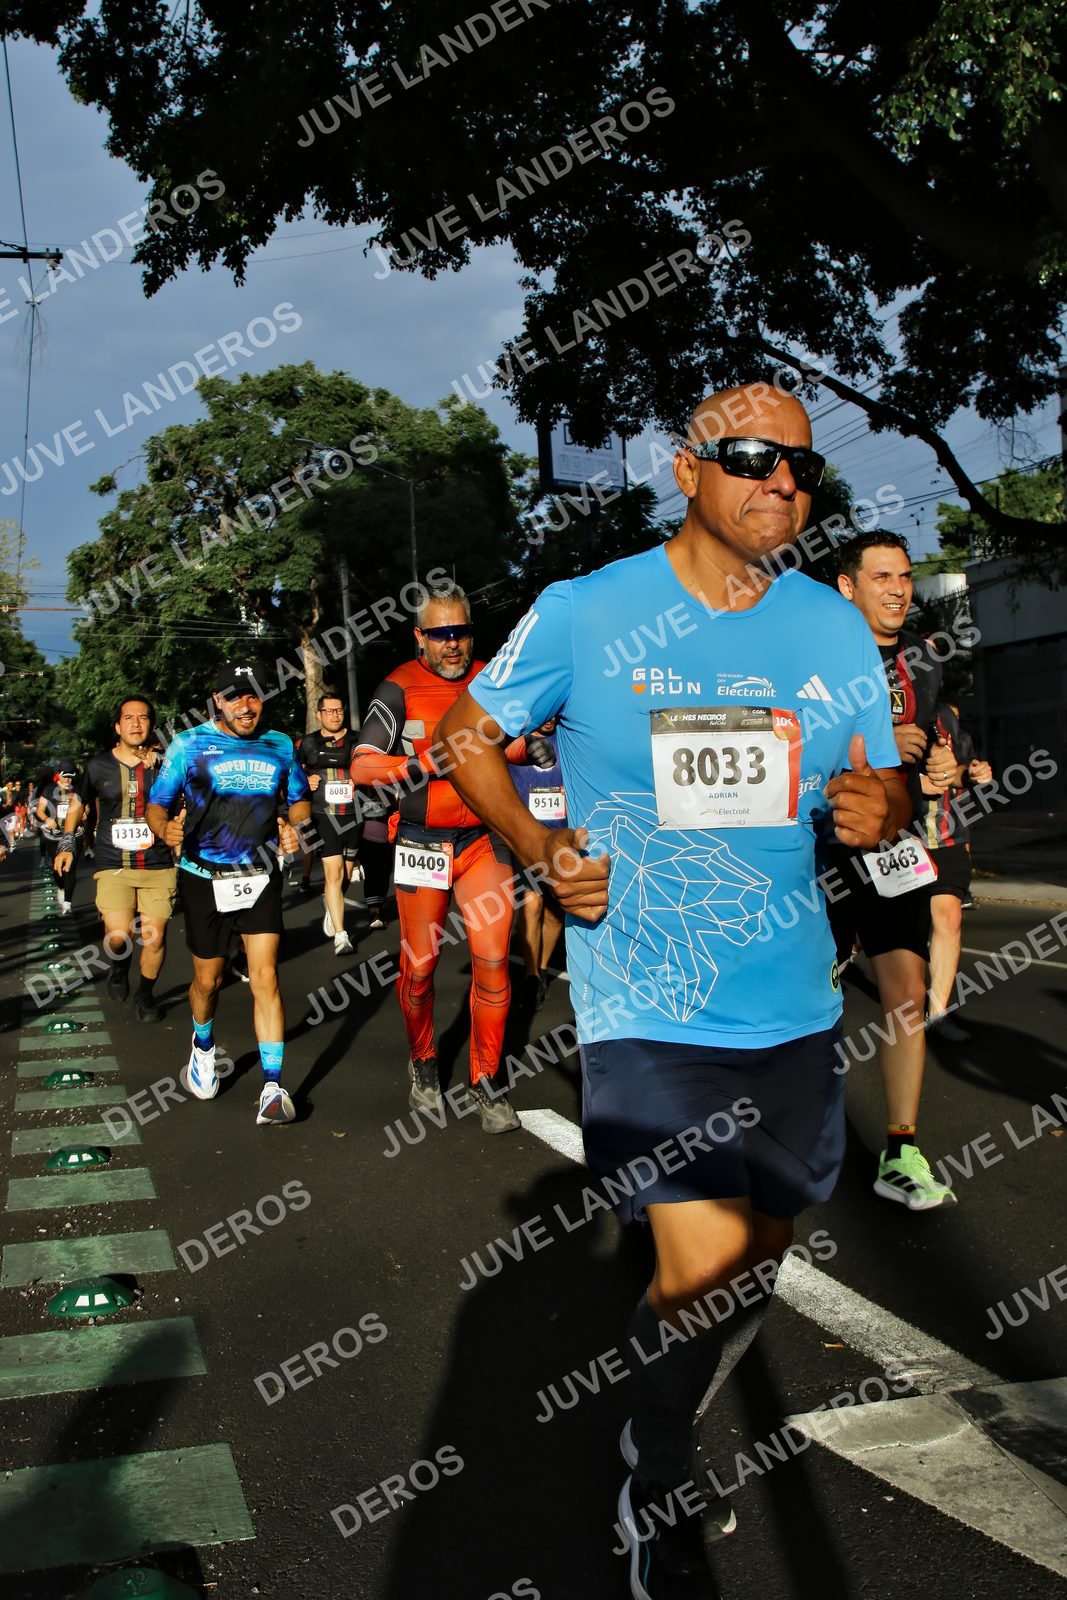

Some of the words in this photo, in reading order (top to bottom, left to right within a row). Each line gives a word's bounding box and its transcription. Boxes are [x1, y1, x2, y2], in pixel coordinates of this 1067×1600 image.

[633, 668, 681, 681] GDL
[651, 683, 701, 695] RUN
[717, 686, 776, 698] Electrolit
[213, 760, 247, 774] SUPER
[248, 760, 277, 775] TEAM
[673, 747, 766, 786] 8033
[329, 787, 348, 795] 8083
[534, 797, 560, 808] 9514
[114, 828, 149, 839] 13134
[399, 852, 446, 872] 10409
[876, 846, 919, 877] 8463
[233, 882, 252, 897] 56
